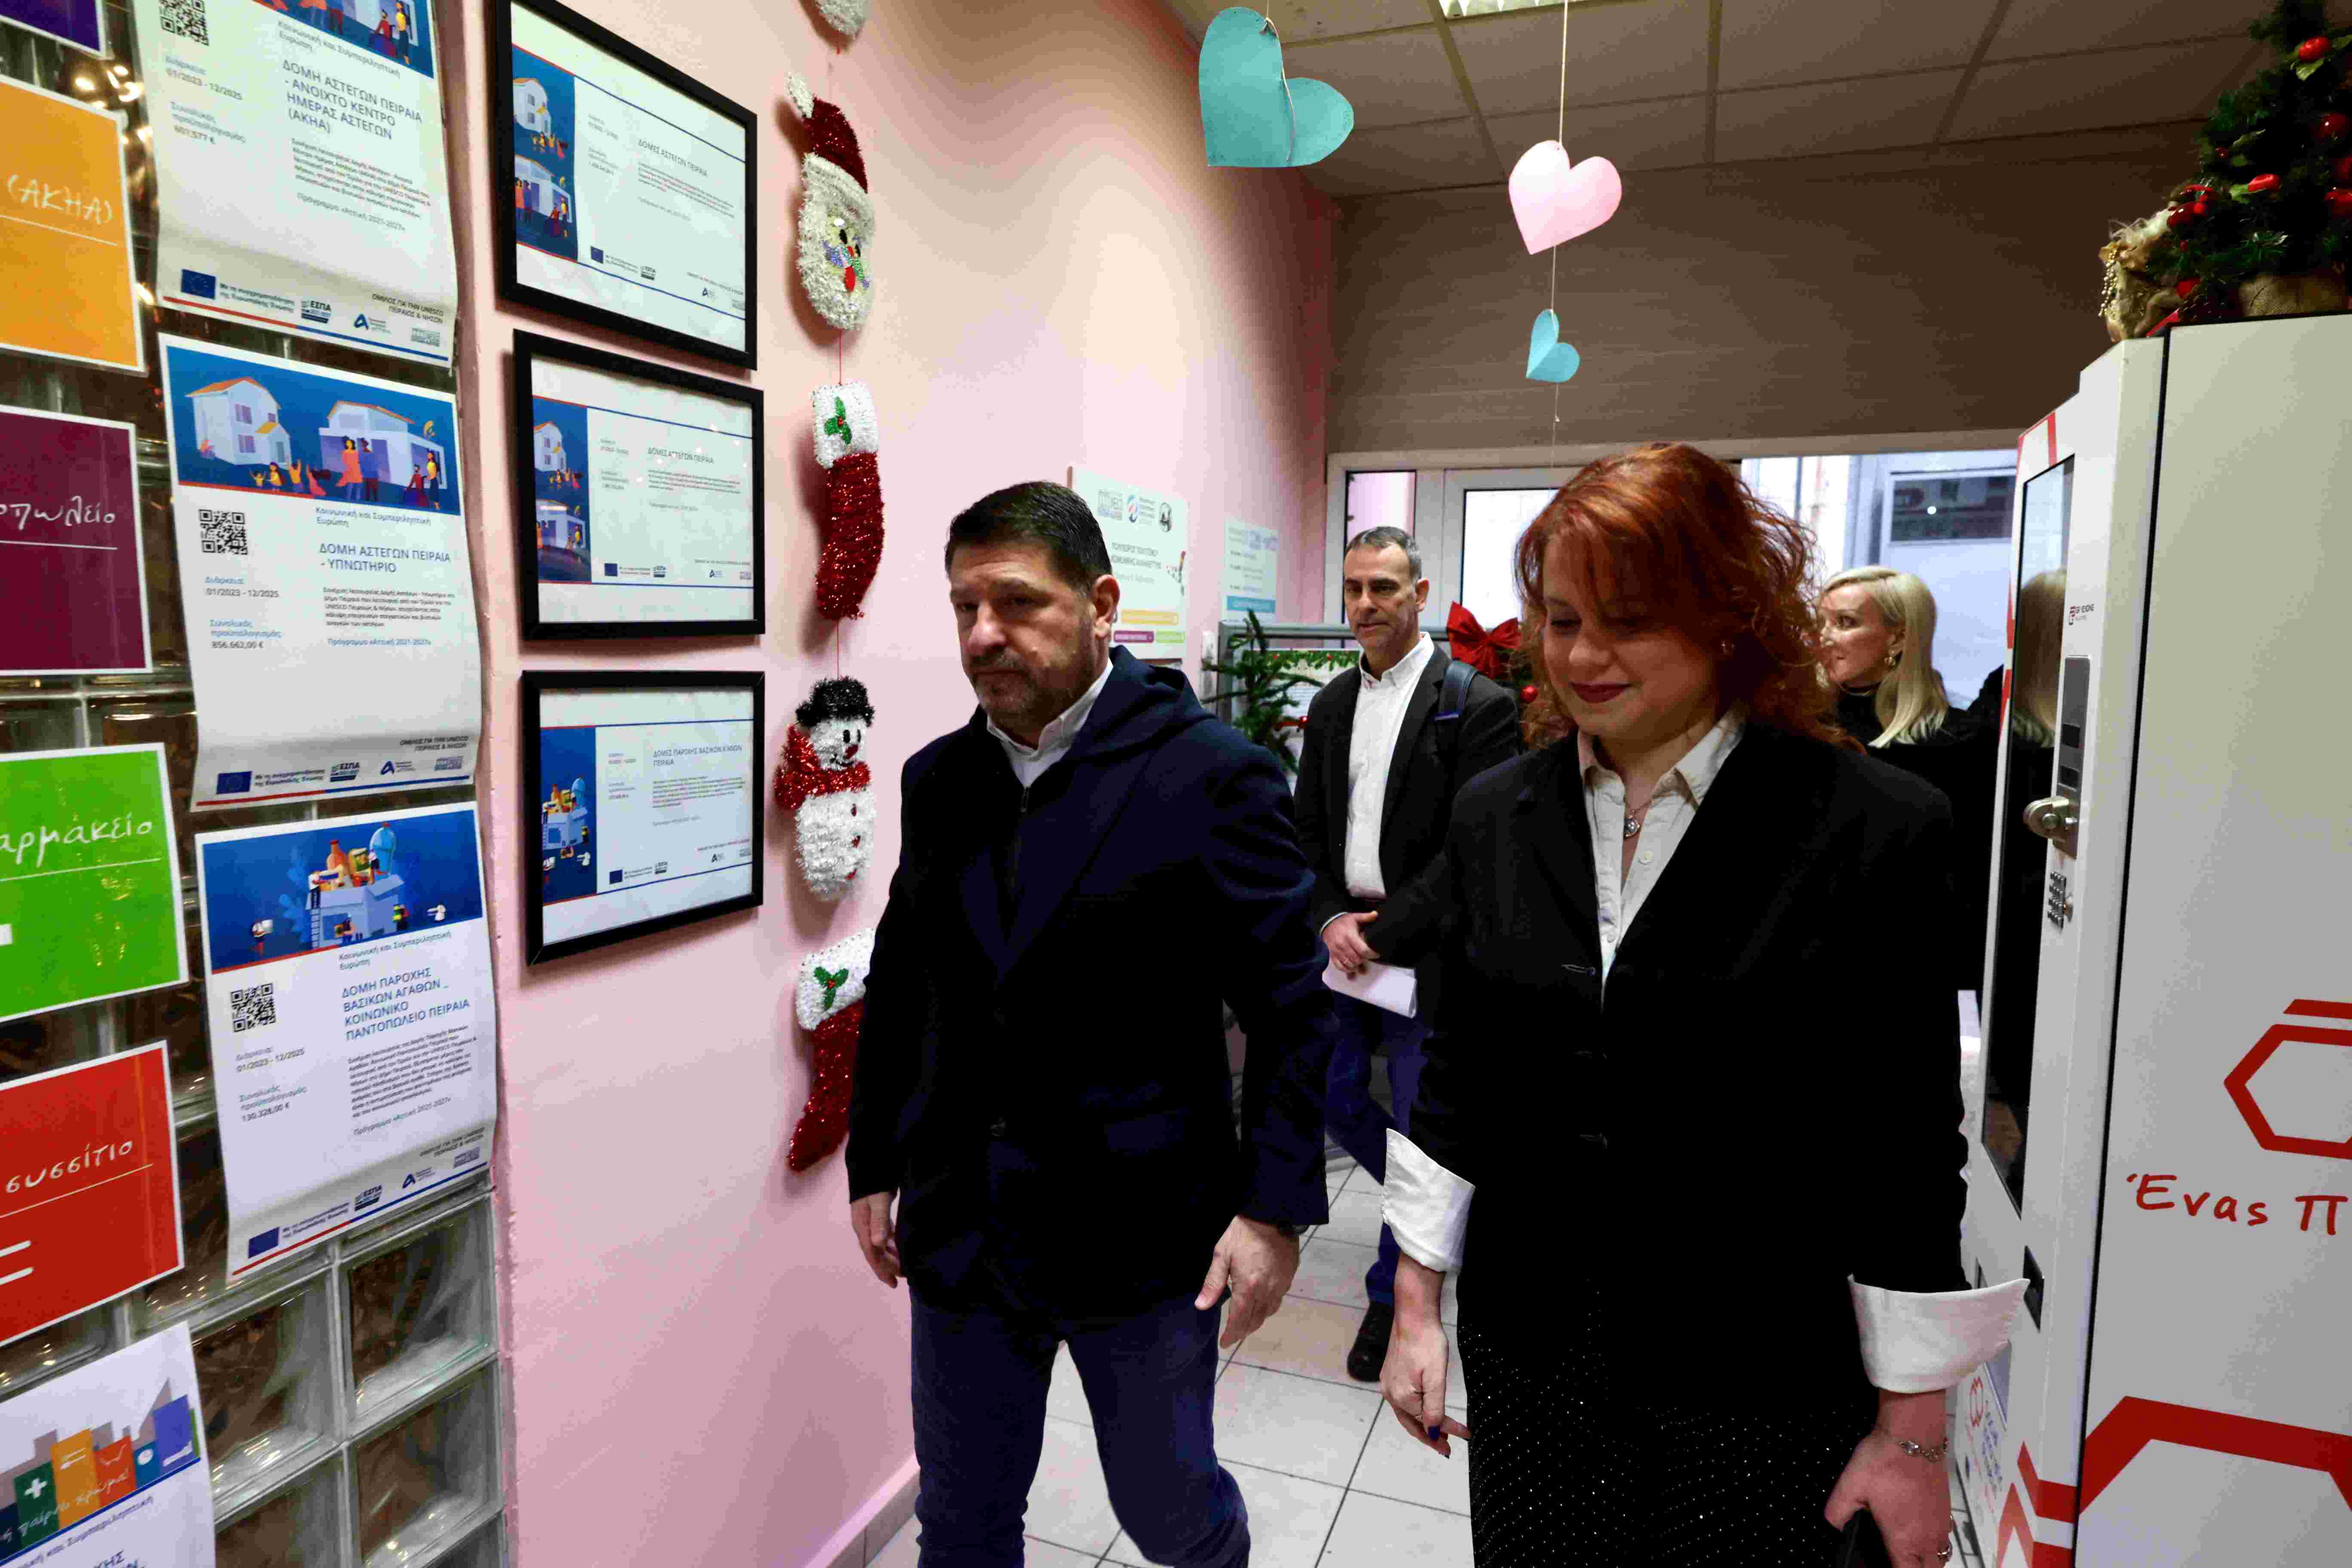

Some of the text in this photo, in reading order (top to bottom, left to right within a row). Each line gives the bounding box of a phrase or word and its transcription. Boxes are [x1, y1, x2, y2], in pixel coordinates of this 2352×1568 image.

[282, 59, 423, 124] ΔΟΜΗ ΑΣΤΕΓΩΝ ΠΕΙΡΑΙΑ
[292, 79, 347, 108] ΑΝΟΙΧΤΟ
[350, 101, 395, 127] ΚΕΝΤΡΟ
[287, 91, 392, 140] ΗΜΕΡΑΣ ΑΣΤΕΓΩΝ
[288, 107, 331, 134] (ΑΚΗΑ)
[7, 173, 113, 225] (ΑΚΗΑ)
[311, 300, 331, 310] ΕΣΠΑ
[316, 516, 349, 528] Ευρώπη
[319, 542, 451, 563] ΔΟΜΗ ΑΣΤΕΓΩΝ ΠΕΙΡΑΙΑ
[328, 558, 397, 573] ΥΠΝΩΤΗΡΙΟ
[206, 588, 241, 597] 01/2023
[248, 588, 279, 598] 12/2025
[258, 640, 264, 649] €
[339, 946, 379, 961] Κοινωνική
[380, 944, 392, 952] και
[340, 959, 371, 971] Ευρώπη
[342, 967, 432, 998] ΔΟΜΗ ΠΑΡΟΧΗΣ
[343, 991, 393, 1013] ΒΑΣΙΚΩΝ
[395, 979, 441, 998] ΑΓΑΘΩΝ
[344, 1001, 409, 1026] ΚΟΙΝΩΝΙΚΟ
[346, 999, 470, 1041] ΠΑΝΤΟΠΩΛΕΙΟ ΠΕΙΡΑΙΑ
[2126, 1173, 2269, 1226] Ένας
